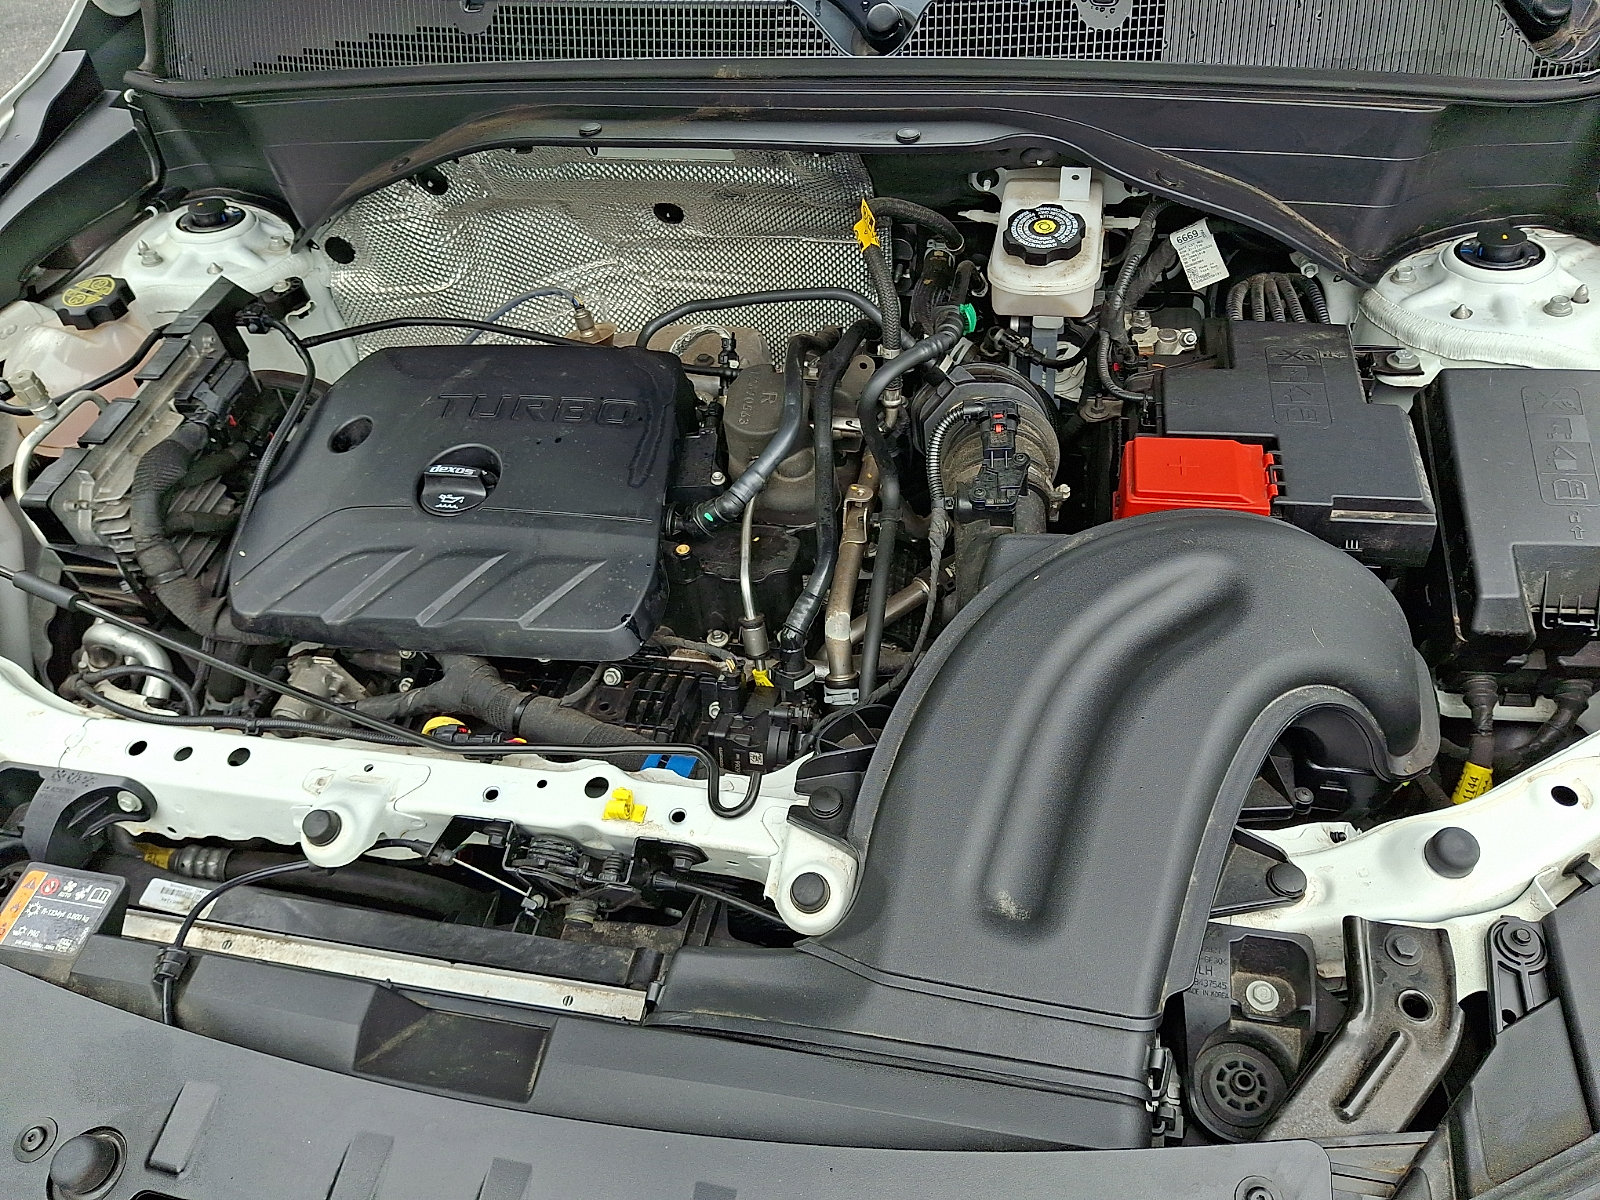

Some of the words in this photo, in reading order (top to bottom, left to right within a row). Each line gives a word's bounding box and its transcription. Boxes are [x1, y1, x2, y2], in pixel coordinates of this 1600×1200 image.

[1176, 229, 1199, 244] 6669
[761, 391, 778, 404] R
[439, 393, 638, 425] TURBO
[429, 464, 477, 476] dexos
[1462, 776, 1480, 800] 1144
[1198, 964, 1213, 977] LH
